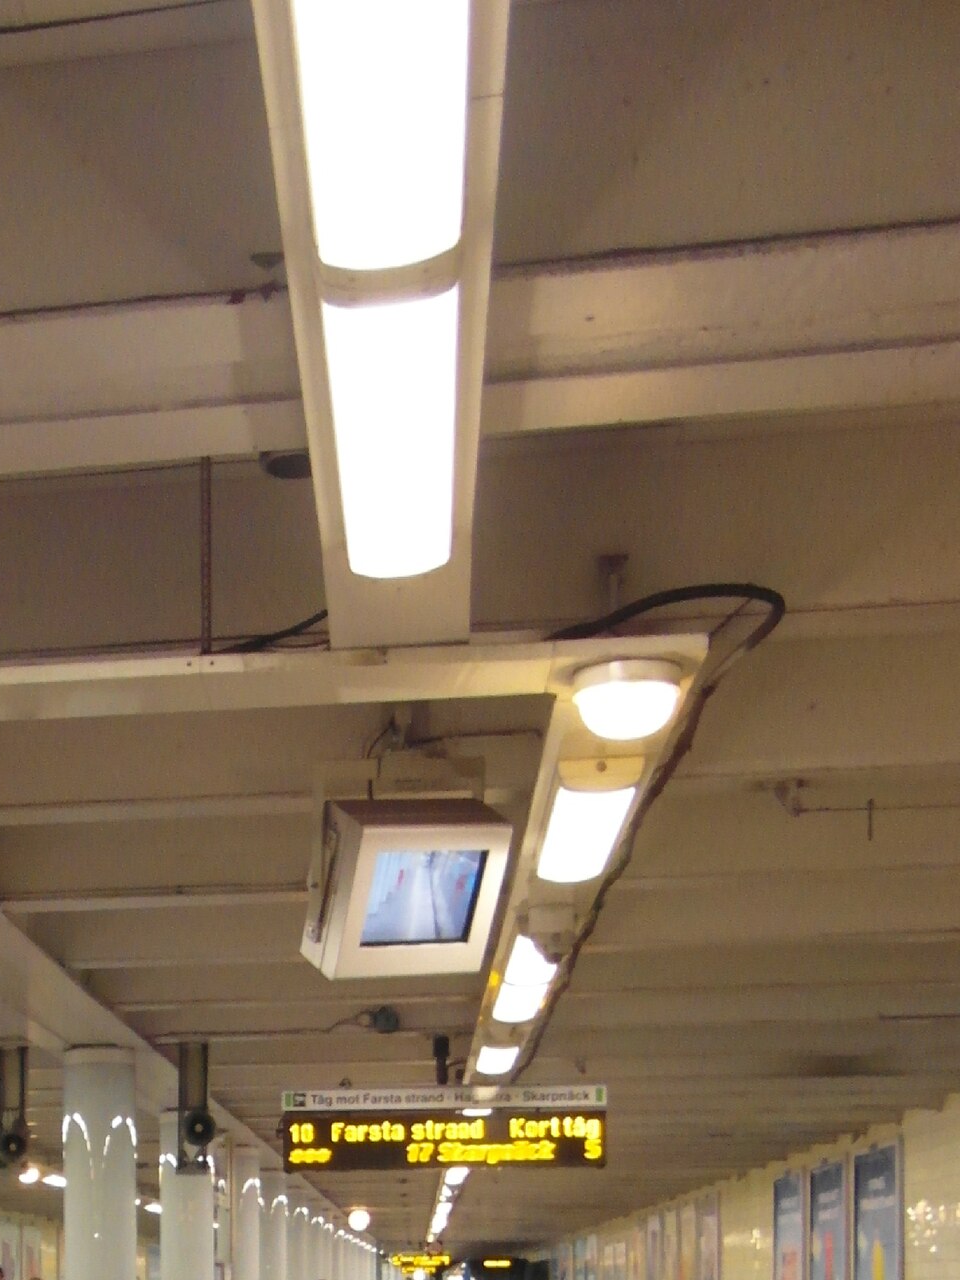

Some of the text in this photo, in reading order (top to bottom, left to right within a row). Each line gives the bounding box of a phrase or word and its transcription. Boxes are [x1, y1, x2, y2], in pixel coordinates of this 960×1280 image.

[363, 1092, 402, 1104] Farsta
[405, 1091, 444, 1104] strand
[523, 1089, 590, 1103] Skarpnäck
[331, 1120, 405, 1143] Farsta
[411, 1118, 485, 1141] strand
[406, 1142, 435, 1163] 17
